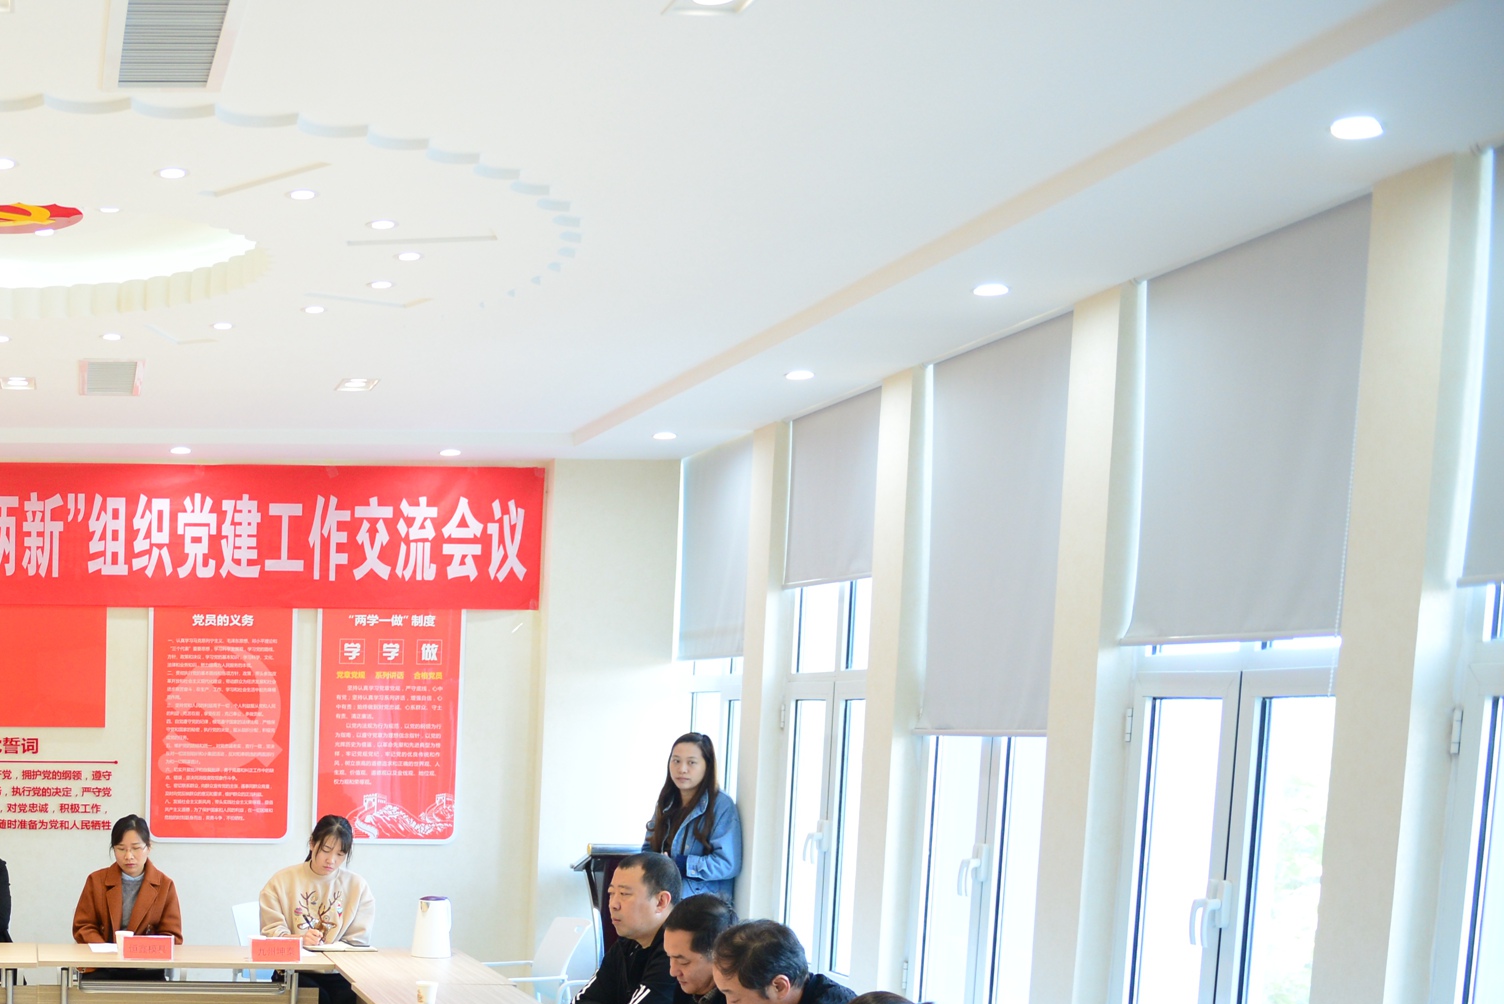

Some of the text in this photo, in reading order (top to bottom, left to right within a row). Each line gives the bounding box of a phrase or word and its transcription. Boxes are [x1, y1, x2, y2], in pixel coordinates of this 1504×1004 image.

[192, 614, 254, 627] 党员的义务
[344, 643, 438, 661] 学 学 做
